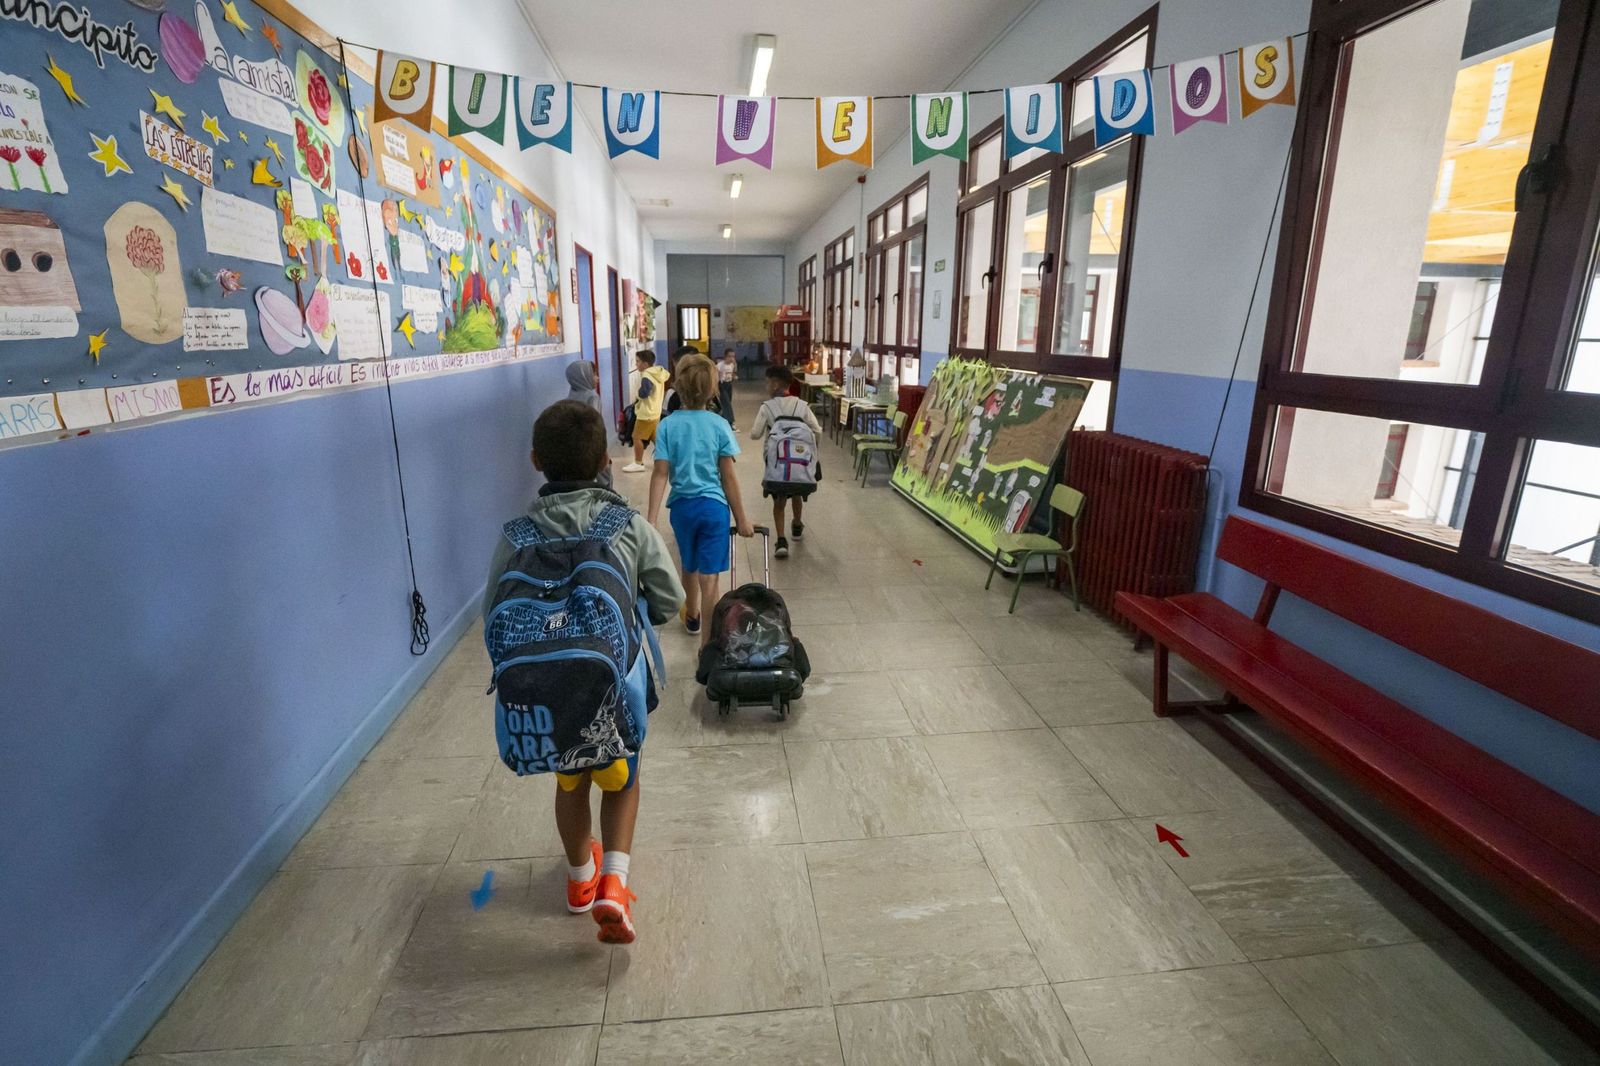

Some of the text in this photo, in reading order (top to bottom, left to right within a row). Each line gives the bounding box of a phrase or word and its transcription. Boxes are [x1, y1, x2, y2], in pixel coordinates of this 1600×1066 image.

[145, 119, 166, 152] LAS
[114, 386, 180, 421] MISMO
[210, 377, 237, 403] Es
[244, 373, 261, 397] lo
[507, 703, 528, 711] THE
